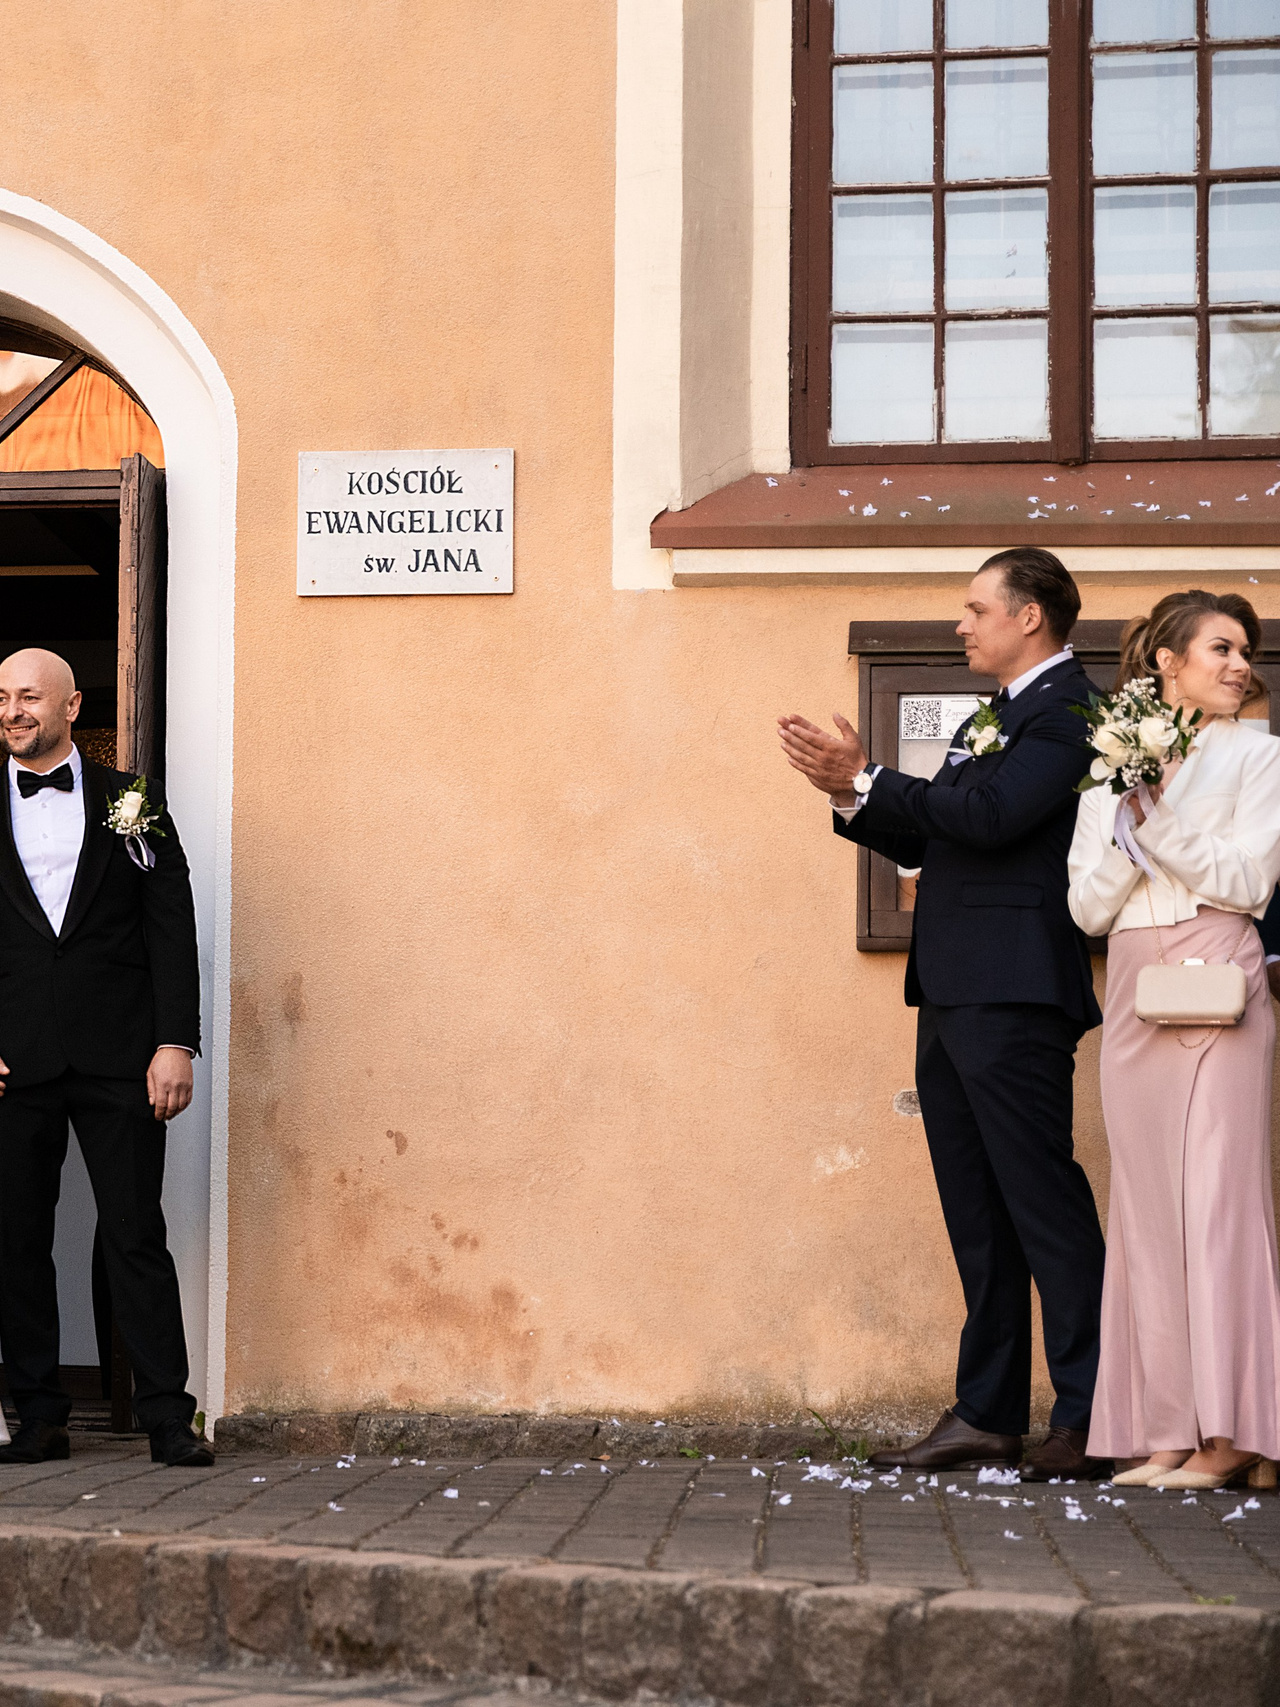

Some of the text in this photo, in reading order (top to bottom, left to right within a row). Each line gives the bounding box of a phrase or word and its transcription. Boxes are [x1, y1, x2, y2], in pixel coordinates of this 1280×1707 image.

[347, 465, 464, 496] KOŚCIÓŁ
[306, 508, 505, 535] EWANGELICKI
[407, 548, 483, 573] JANA
[945, 708, 972, 719] Zapras
